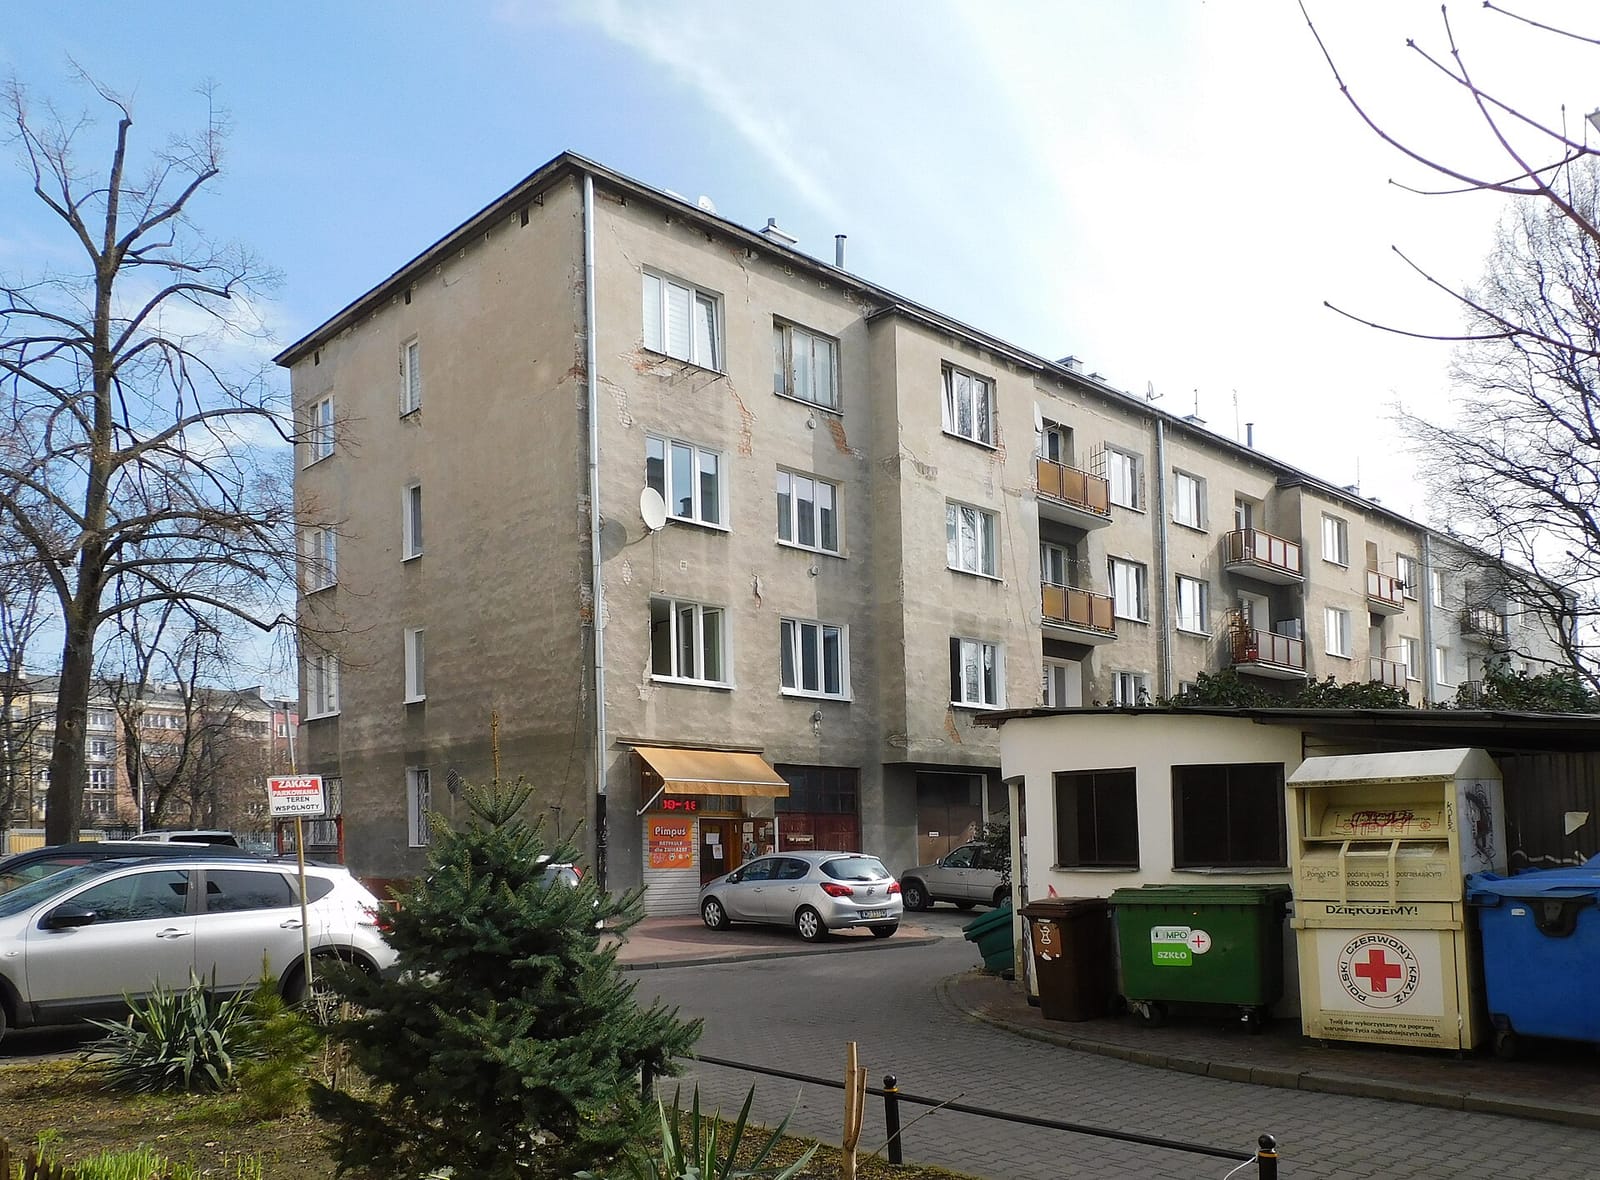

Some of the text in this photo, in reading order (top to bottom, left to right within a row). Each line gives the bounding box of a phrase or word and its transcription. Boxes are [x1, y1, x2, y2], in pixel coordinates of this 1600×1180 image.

[278, 780, 312, 788] ZAKAZ
[273, 789, 319, 797] PARKOWANIA
[655, 826, 687, 837] Pimpuś
[1167, 931, 1187, 939] MPO
[1346, 936, 1413, 961] CZERWONY
[1157, 951, 1187, 959] SZKŁO
[1341, 961, 1367, 1002] POLSKI
